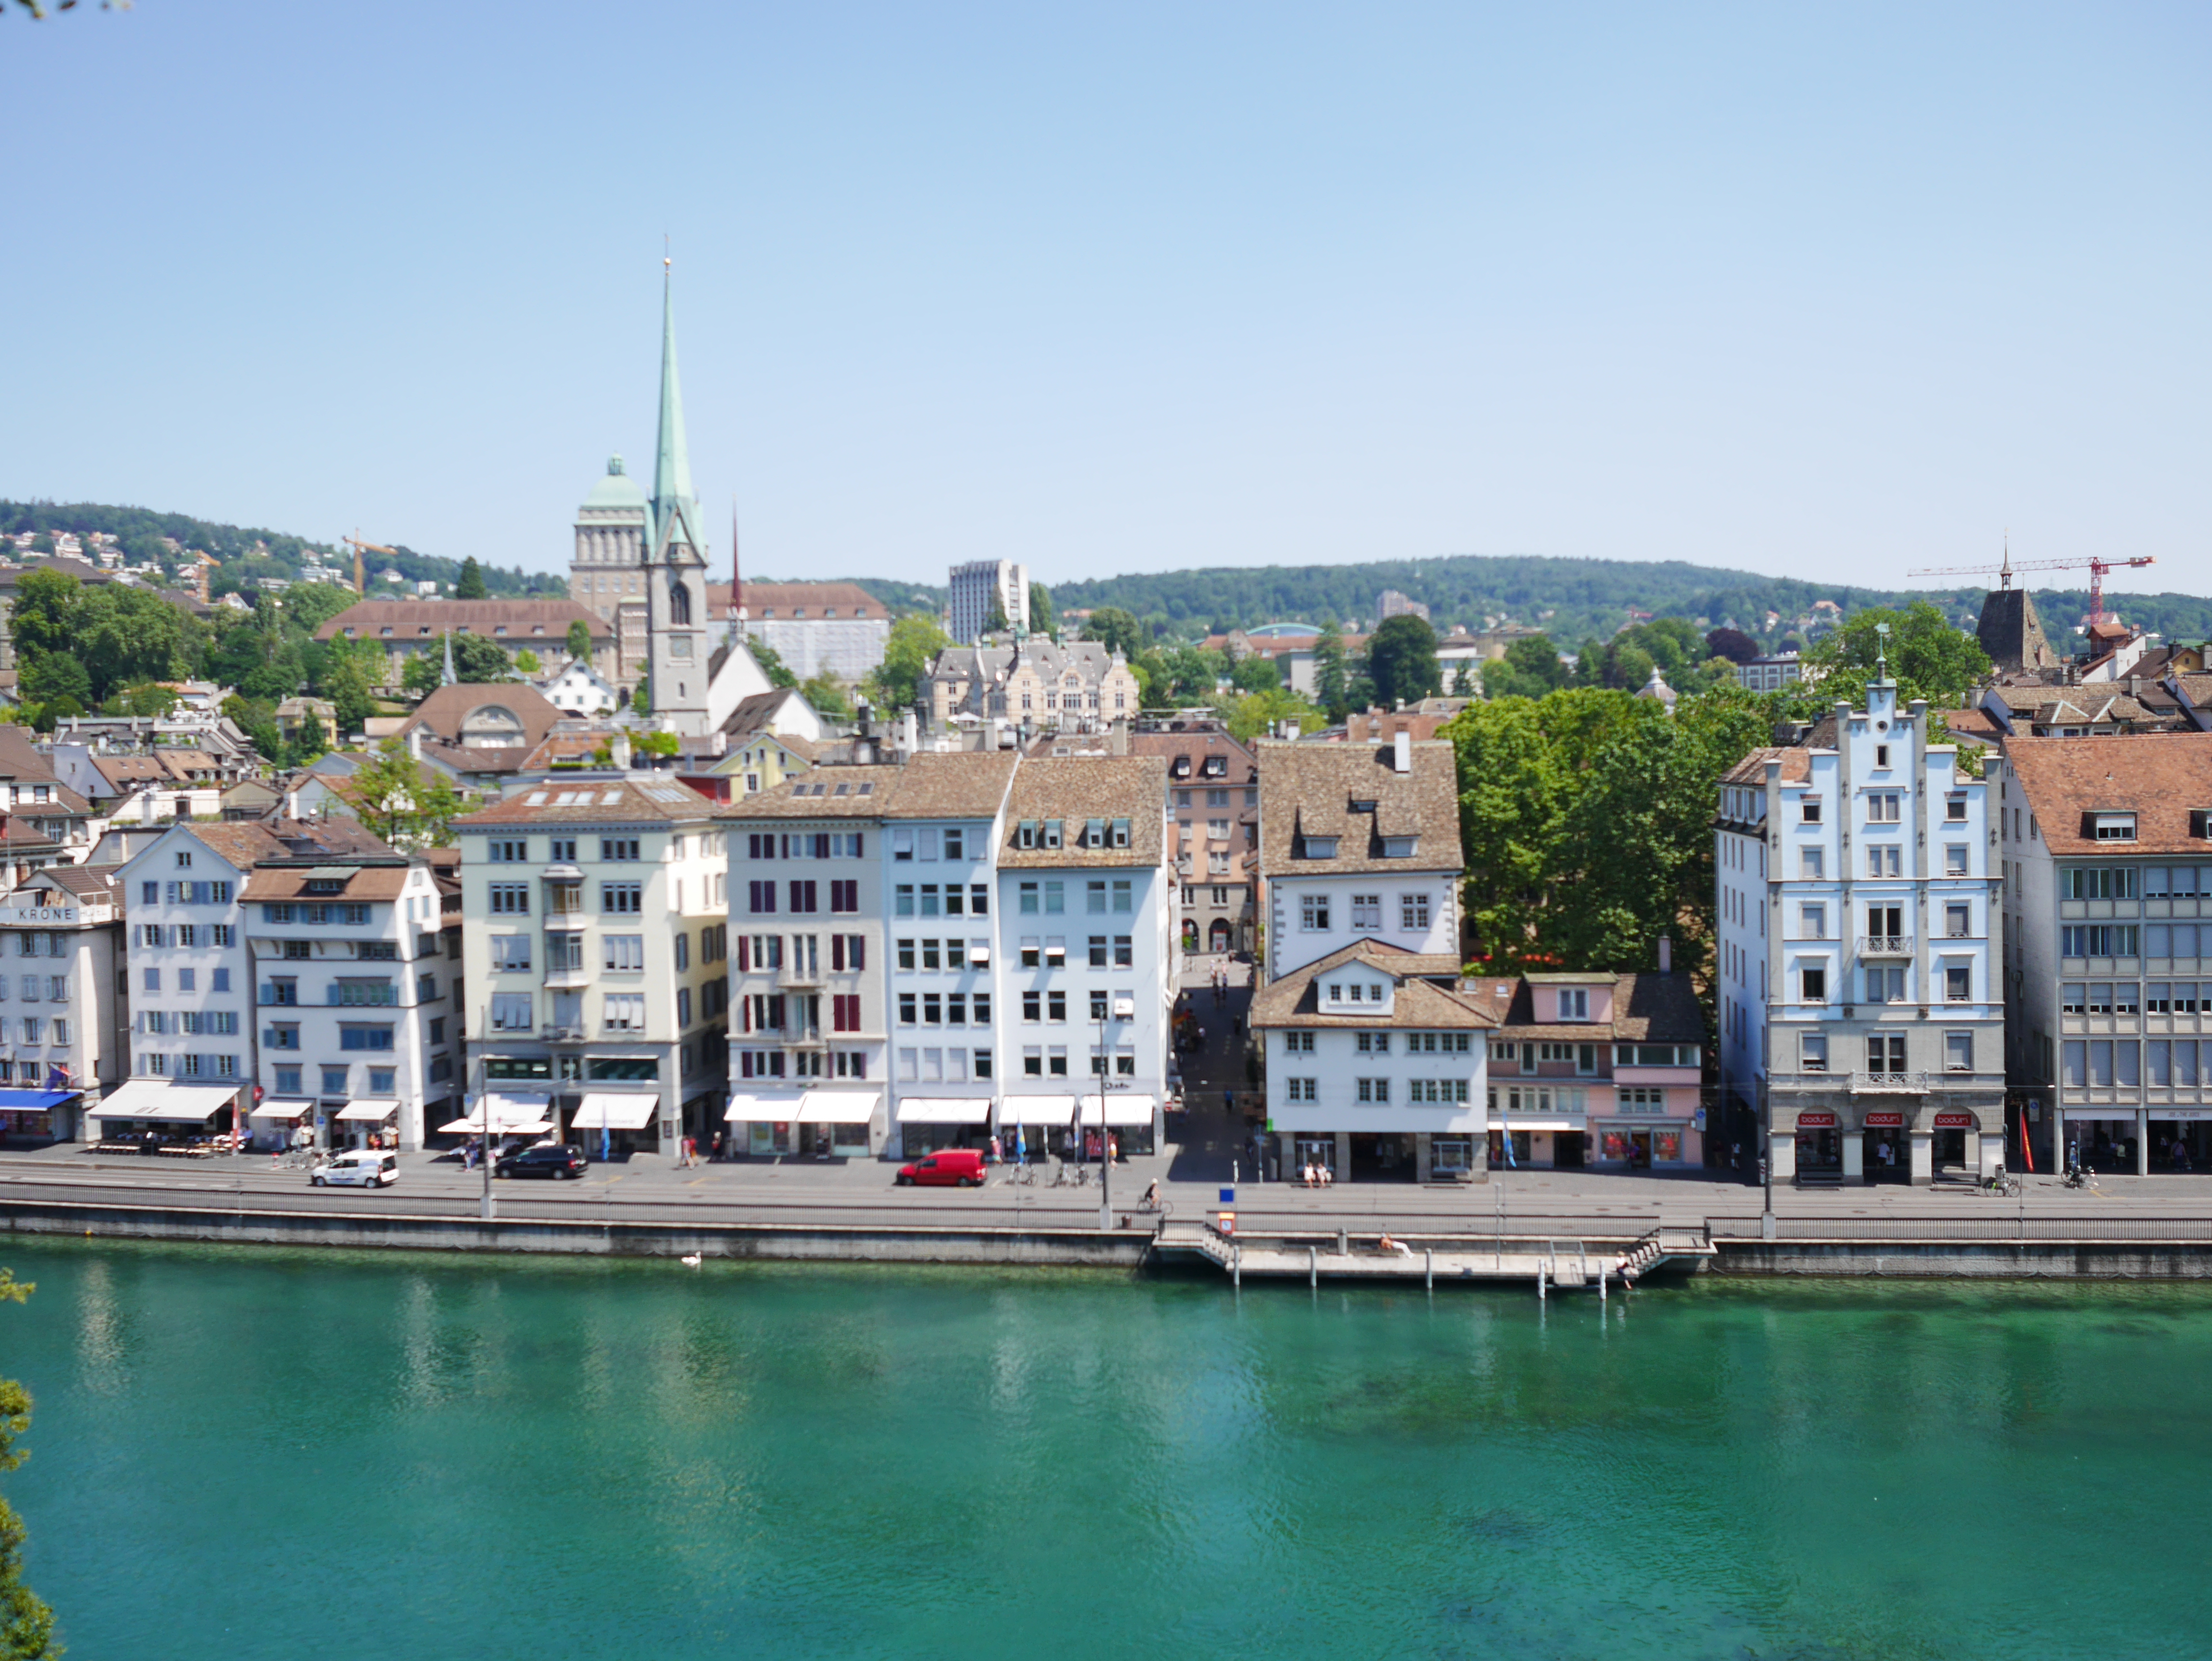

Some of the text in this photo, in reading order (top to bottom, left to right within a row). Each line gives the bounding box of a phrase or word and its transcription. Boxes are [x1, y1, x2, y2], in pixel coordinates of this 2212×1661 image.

[18, 909, 72, 920] KRONE
[79, 908, 107, 918] HOTEL
[1937, 1116, 1969, 1124] bodum
